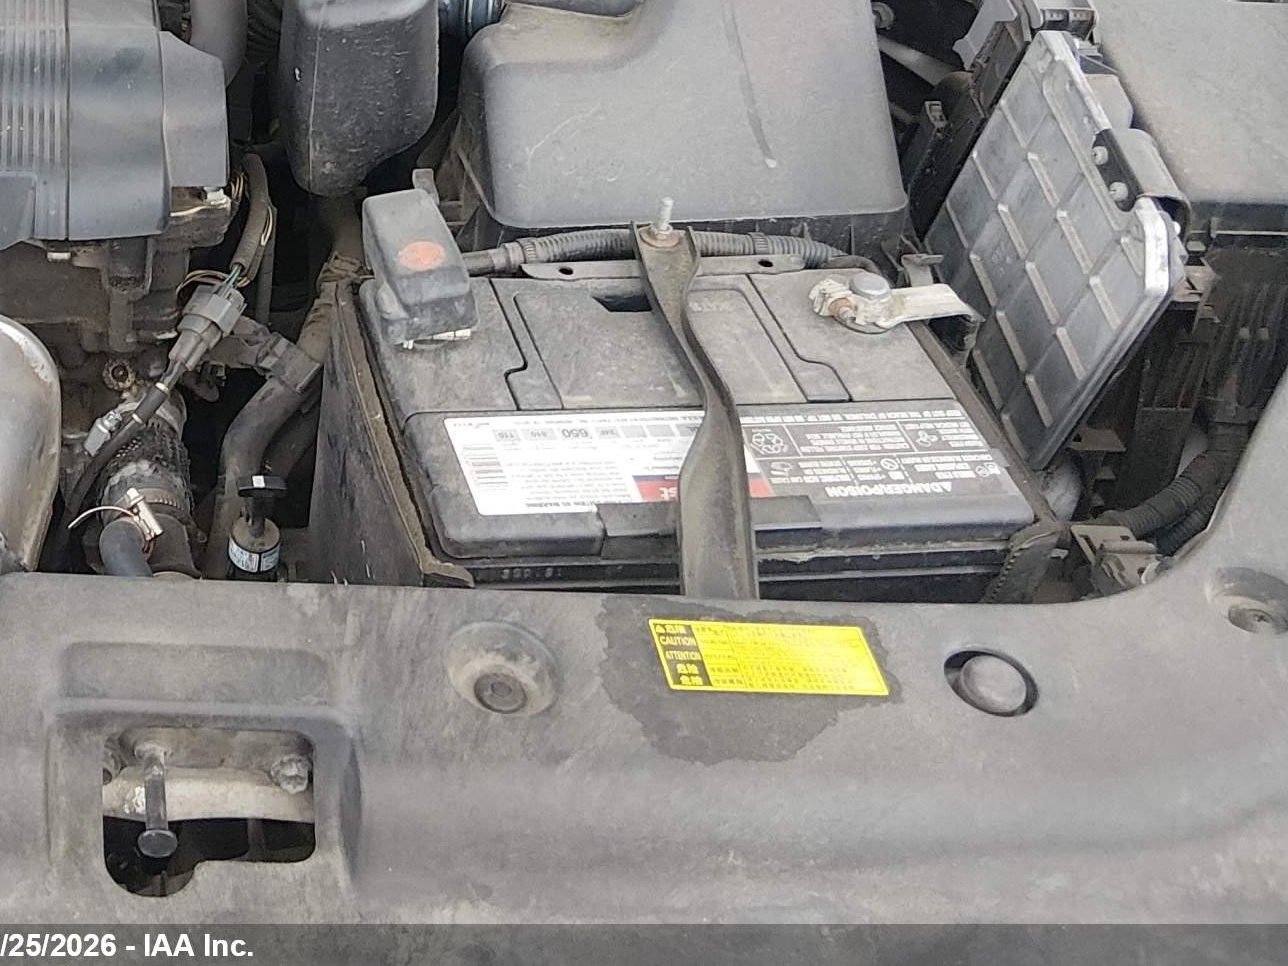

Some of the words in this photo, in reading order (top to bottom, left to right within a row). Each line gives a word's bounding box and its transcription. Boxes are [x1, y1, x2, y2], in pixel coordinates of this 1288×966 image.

[561, 428, 589, 439] 650
[659, 636, 697, 646] CAUTION
[665, 650, 702, 661] ATTENTION
